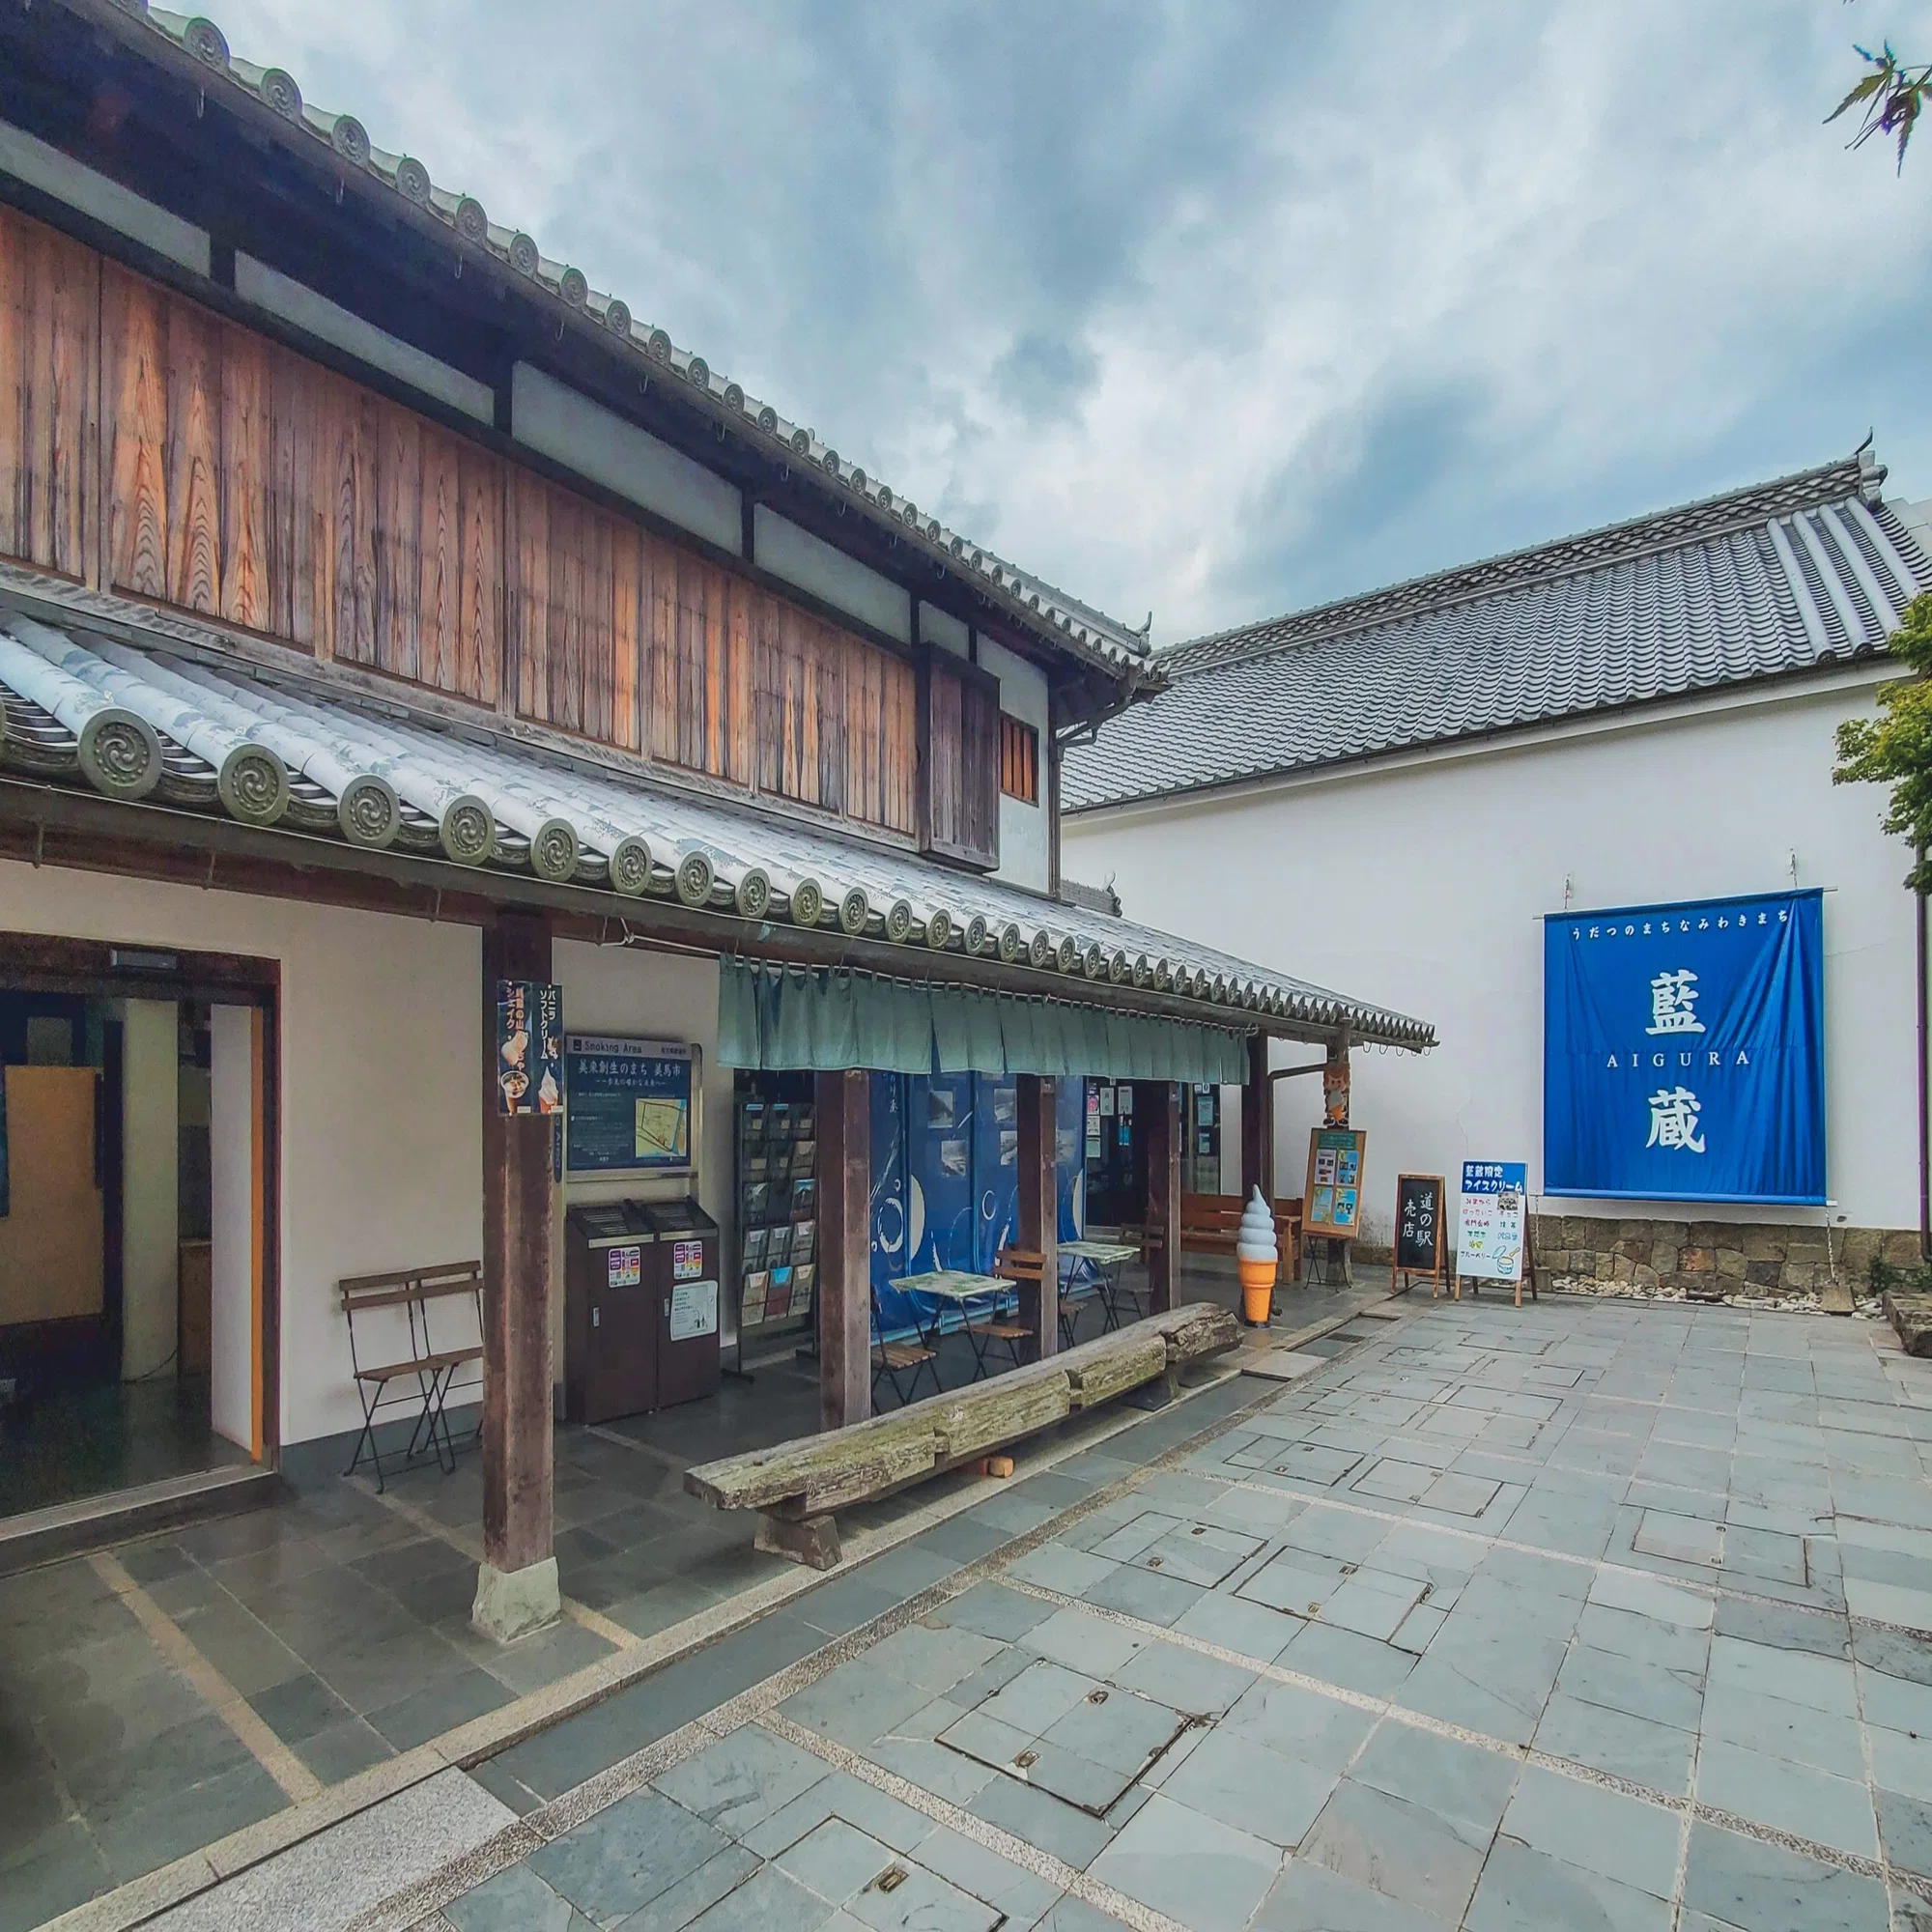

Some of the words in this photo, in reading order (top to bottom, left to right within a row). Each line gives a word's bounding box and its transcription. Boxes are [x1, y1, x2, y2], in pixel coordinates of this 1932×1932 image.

[1572, 909, 1788, 941] うだつのまちなみわきまち
[1645, 969, 1706, 1036] 藍
[540, 989, 549, 1060] ソフトクリーム
[584, 1041, 619, 1053] Smoking
[623, 1042, 642, 1054] Area
[1605, 1050, 1750, 1068] AIGURA
[654, 1063, 681, 1077] 美馬市
[1645, 1086, 1706, 1153] 蔵
[1464, 1179, 1523, 1193] アイスクリーム
[1403, 1198, 1417, 1237] 売店
[1415, 1191, 1435, 1247] 道の駅
